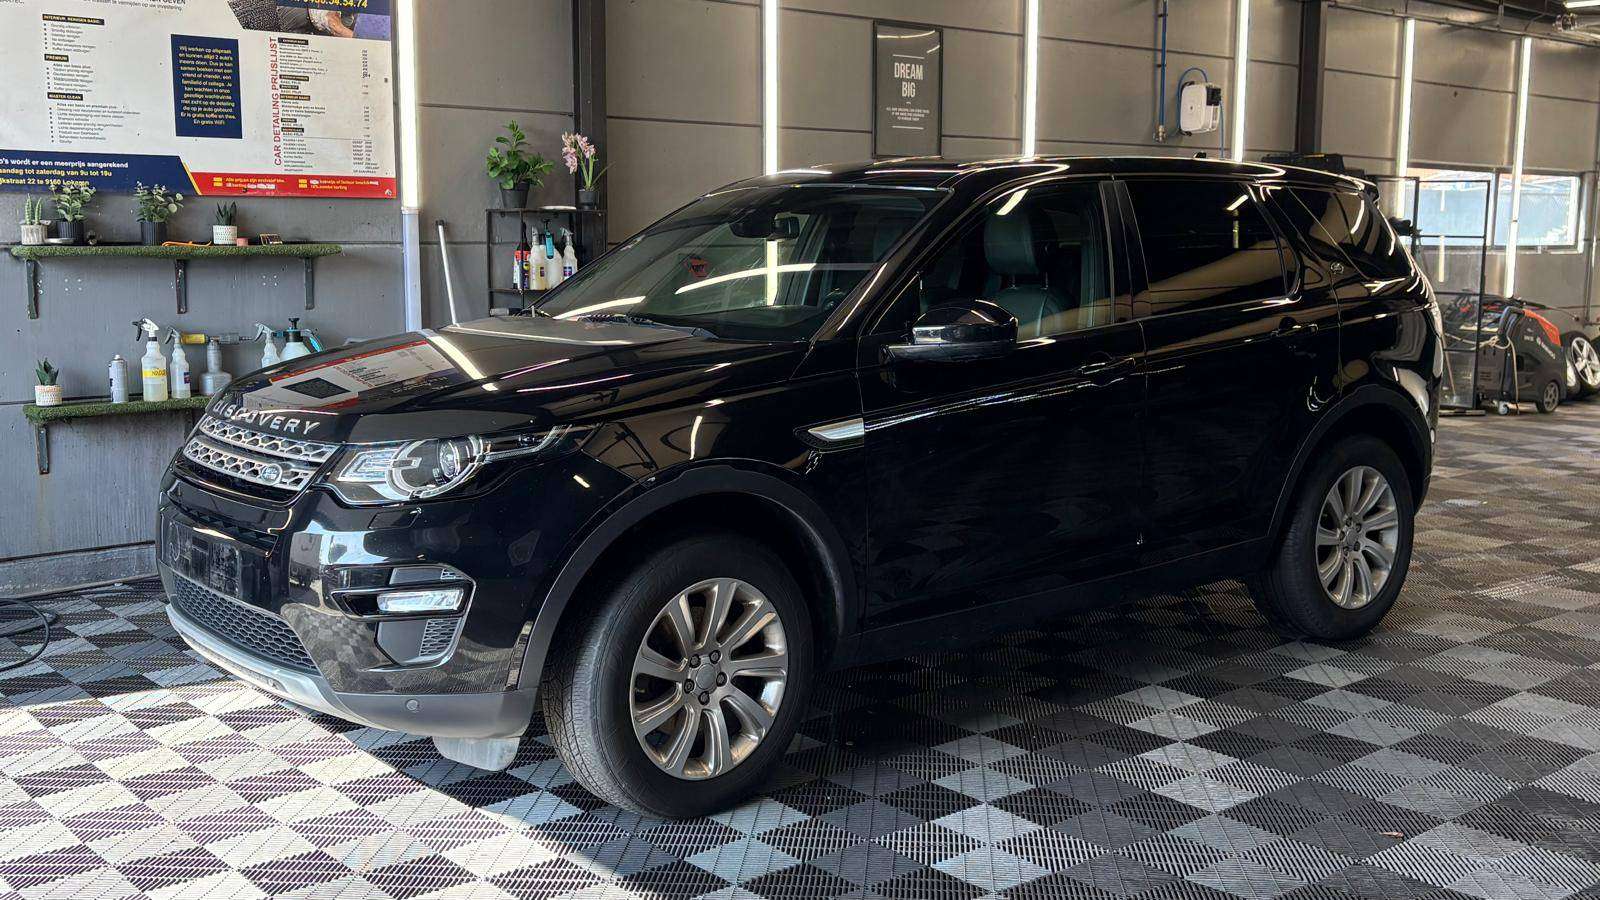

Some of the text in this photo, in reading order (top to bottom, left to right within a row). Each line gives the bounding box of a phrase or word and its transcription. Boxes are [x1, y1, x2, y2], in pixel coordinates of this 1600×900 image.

[304, 0, 368, 8] .54.54.74
[894, 62, 924, 80] DREAM
[901, 81, 916, 98] BIG
[270, 37, 282, 165] CAR DETAILING PRIJSLIJST
[11, 158, 30, 166] wordt
[212, 400, 320, 435] DISCOVERY
